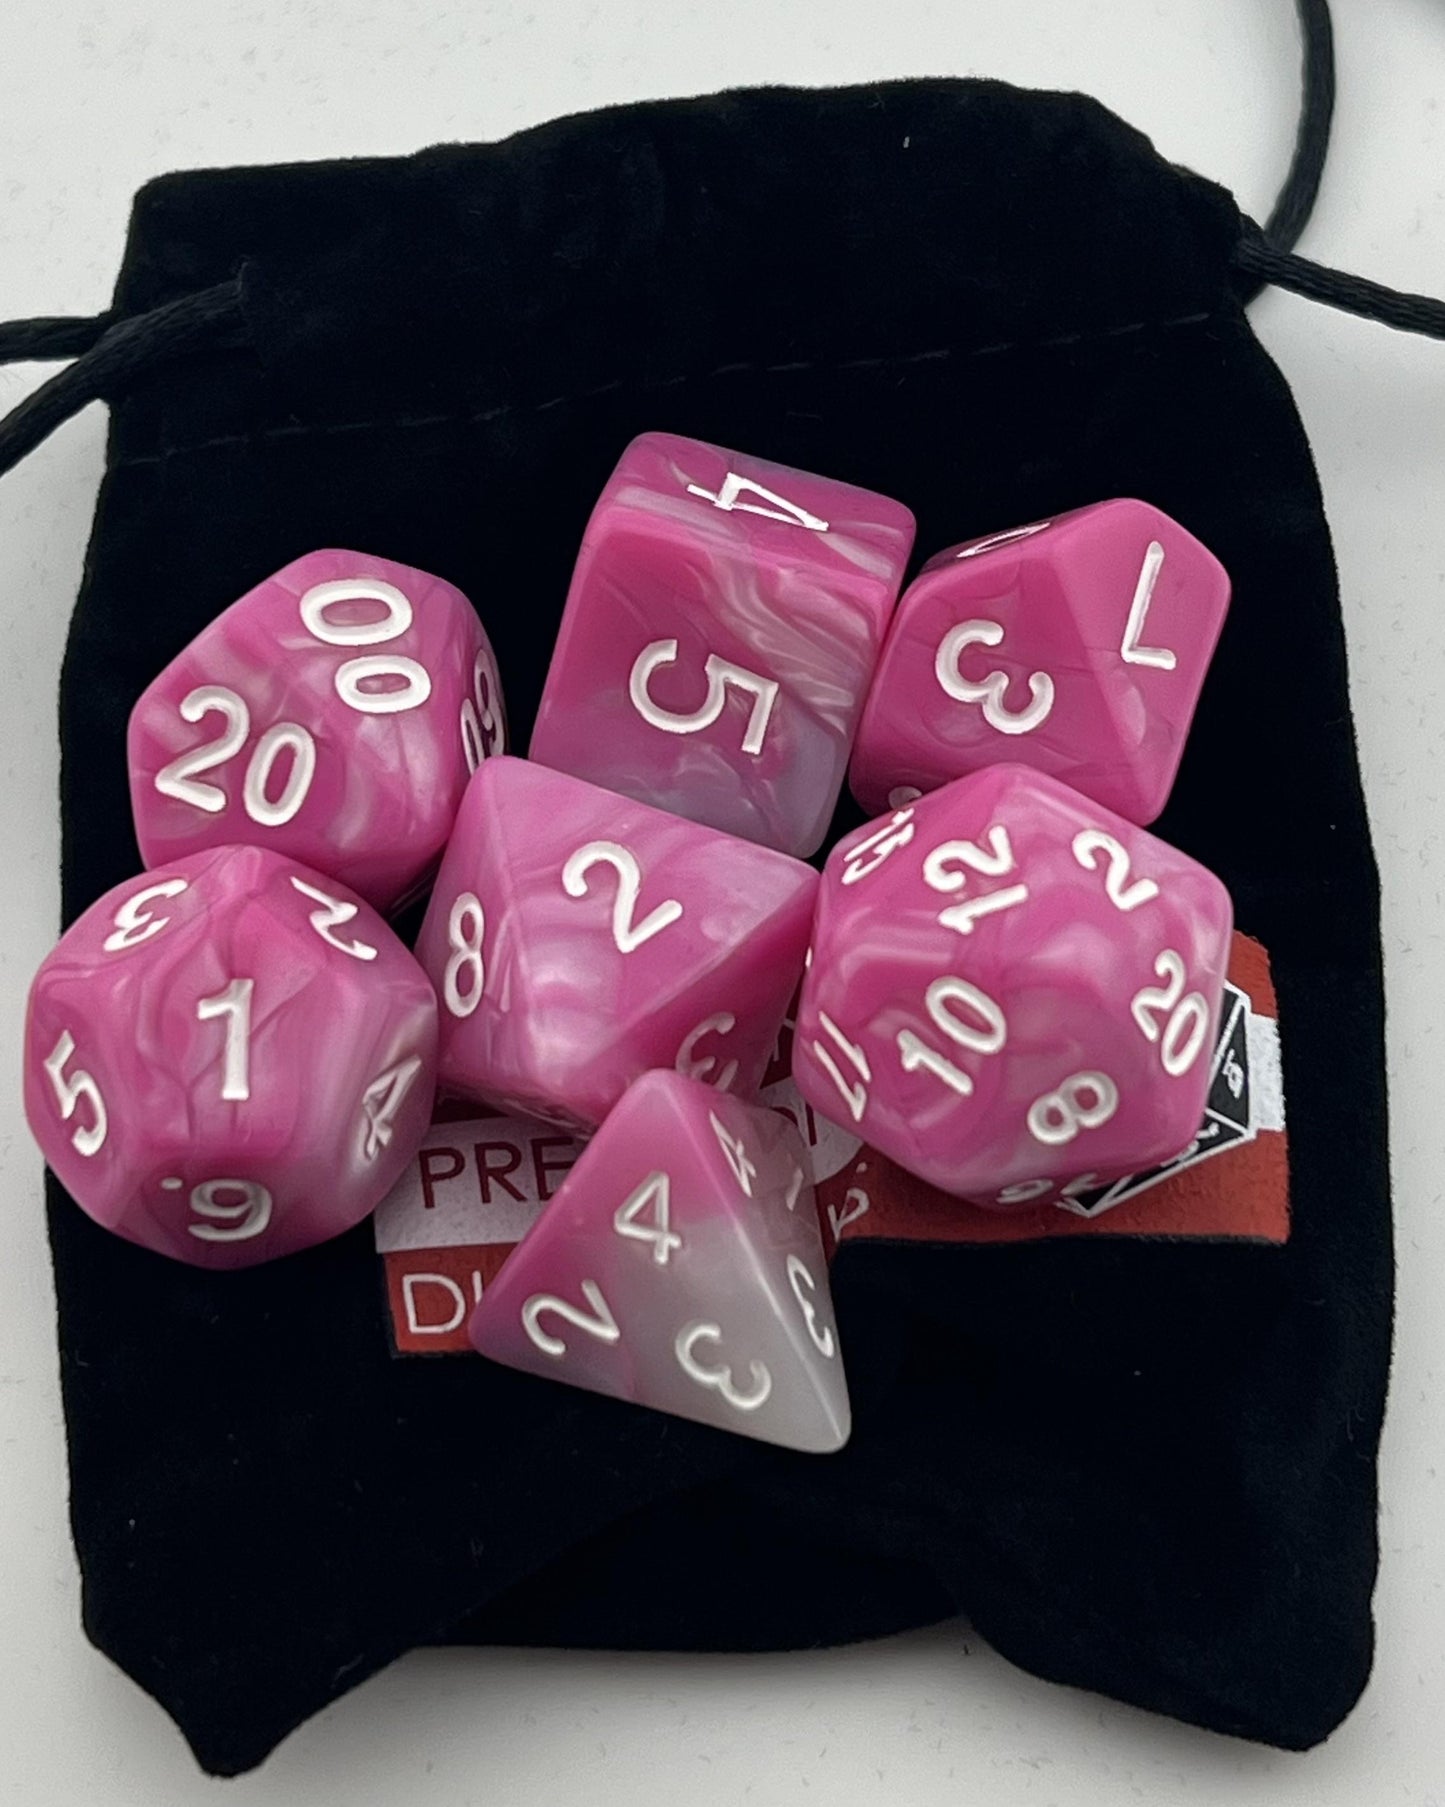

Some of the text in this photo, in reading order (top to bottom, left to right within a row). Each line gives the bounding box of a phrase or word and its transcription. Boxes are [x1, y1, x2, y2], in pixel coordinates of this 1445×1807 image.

[687, 472, 829, 531] 4
[300, 578, 431, 714] 00
[1121, 541, 1176, 670] 7
[629, 639, 778, 755] 5
[936, 620, 1055, 734] 3
[155, 685, 315, 826] 20
[103, 879, 188, 951] 3
[290, 876, 377, 960] 2
[562, 840, 683, 954] 2
[923, 825, 1029, 935] 12
[1072, 829, 1159, 911] 2
[444, 892, 484, 1017] 8
[198, 979, 253, 1100] 1
[896, 975, 1006, 1096] 10
[1130, 949, 1209, 1076] 20
[43, 1030, 107, 1157] 5
[360, 1058, 421, 1160] 4
[1027, 1070, 1118, 1145] 8
[710, 1111, 757, 1198] 4
[614, 1171, 682, 1266] 4
[522, 1280, 620, 1355] 2
[787, 1255, 834, 1358] 3
[675, 1323, 771, 1411] 3
